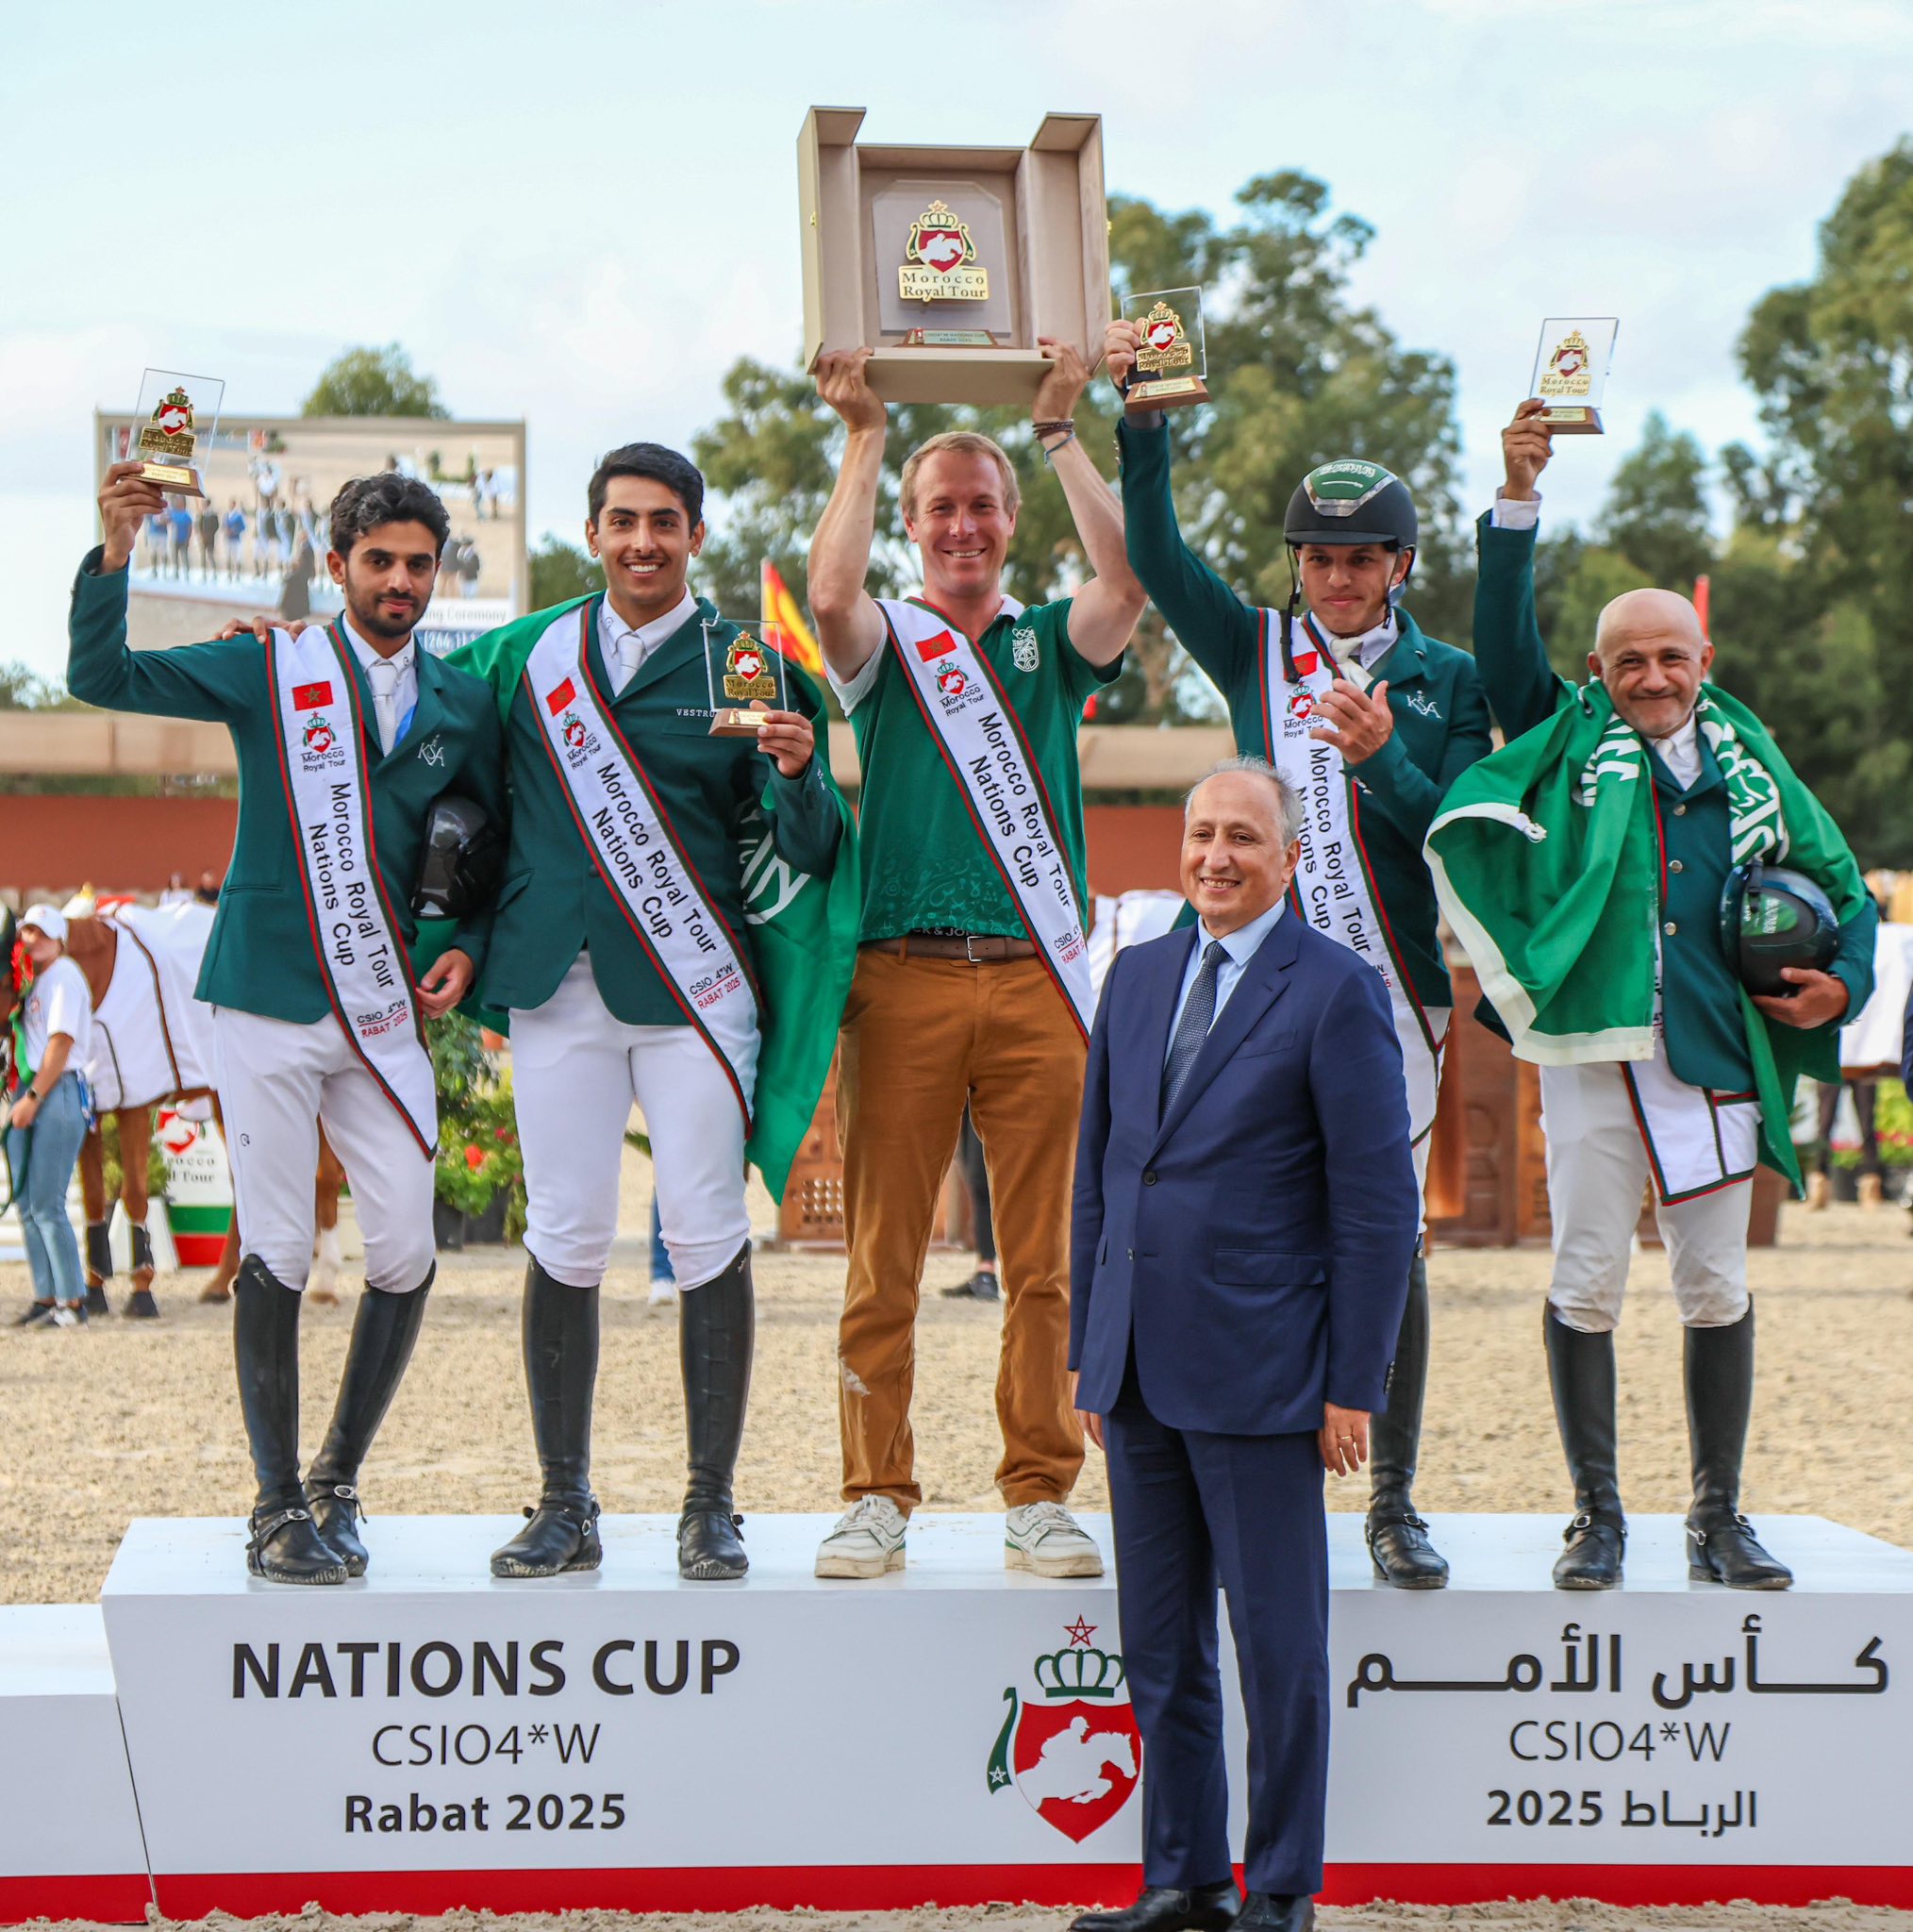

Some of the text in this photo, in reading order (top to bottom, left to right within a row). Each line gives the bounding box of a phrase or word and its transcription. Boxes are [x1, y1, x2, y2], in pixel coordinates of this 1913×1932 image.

[903, 273, 984, 285] Morocco
[904, 286, 986, 300] Royal Tour
[1540, 386, 1564, 395] Royal
[726, 679, 774, 688] Morocco
[728, 689, 774, 698] Royal Tour
[941, 686, 981, 709] Morocco
[945, 694, 985, 717] Royal Tour
[676, 708, 717, 718] VESTRU
[1284, 716, 1322, 729] Morocco
[1284, 727, 1304, 738] Royal
[302, 750, 344, 763] Morocco
[568, 736, 597, 762] Morocco
[572, 743, 602, 770] Royal Tour
[304, 759, 345, 773] Royal Tour
[978, 711, 1070, 907] Morocco Royal Tour
[969, 755, 1040, 888] Nations Cup
[597, 762, 717, 954] Morocco Royal Tour
[1309, 746, 1371, 953] Morocco Royal Tour
[592, 807, 673, 939] Nations Cup
[308, 824, 355, 965] Nations Cup
[330, 783, 394, 988] Morocco Royal Tour
[1311, 885, 1331, 929] Cup
[1054, 932, 1073, 949] CSIO
[1061, 944, 1081, 964] RABAT
[690, 977, 712, 995] CSIO
[697, 977, 741, 1010] RABAT 2025
[357, 1011, 383, 1024] CSIO
[361, 1010, 408, 1039] RABAT 2025
[183, 1171, 215, 1183] Tour
[233, 1640, 740, 1698] NATIONS CUP
[344, 1792, 626, 1833] Rabat 2025
[1487, 1790, 1756, 1838] الرباط 2025
